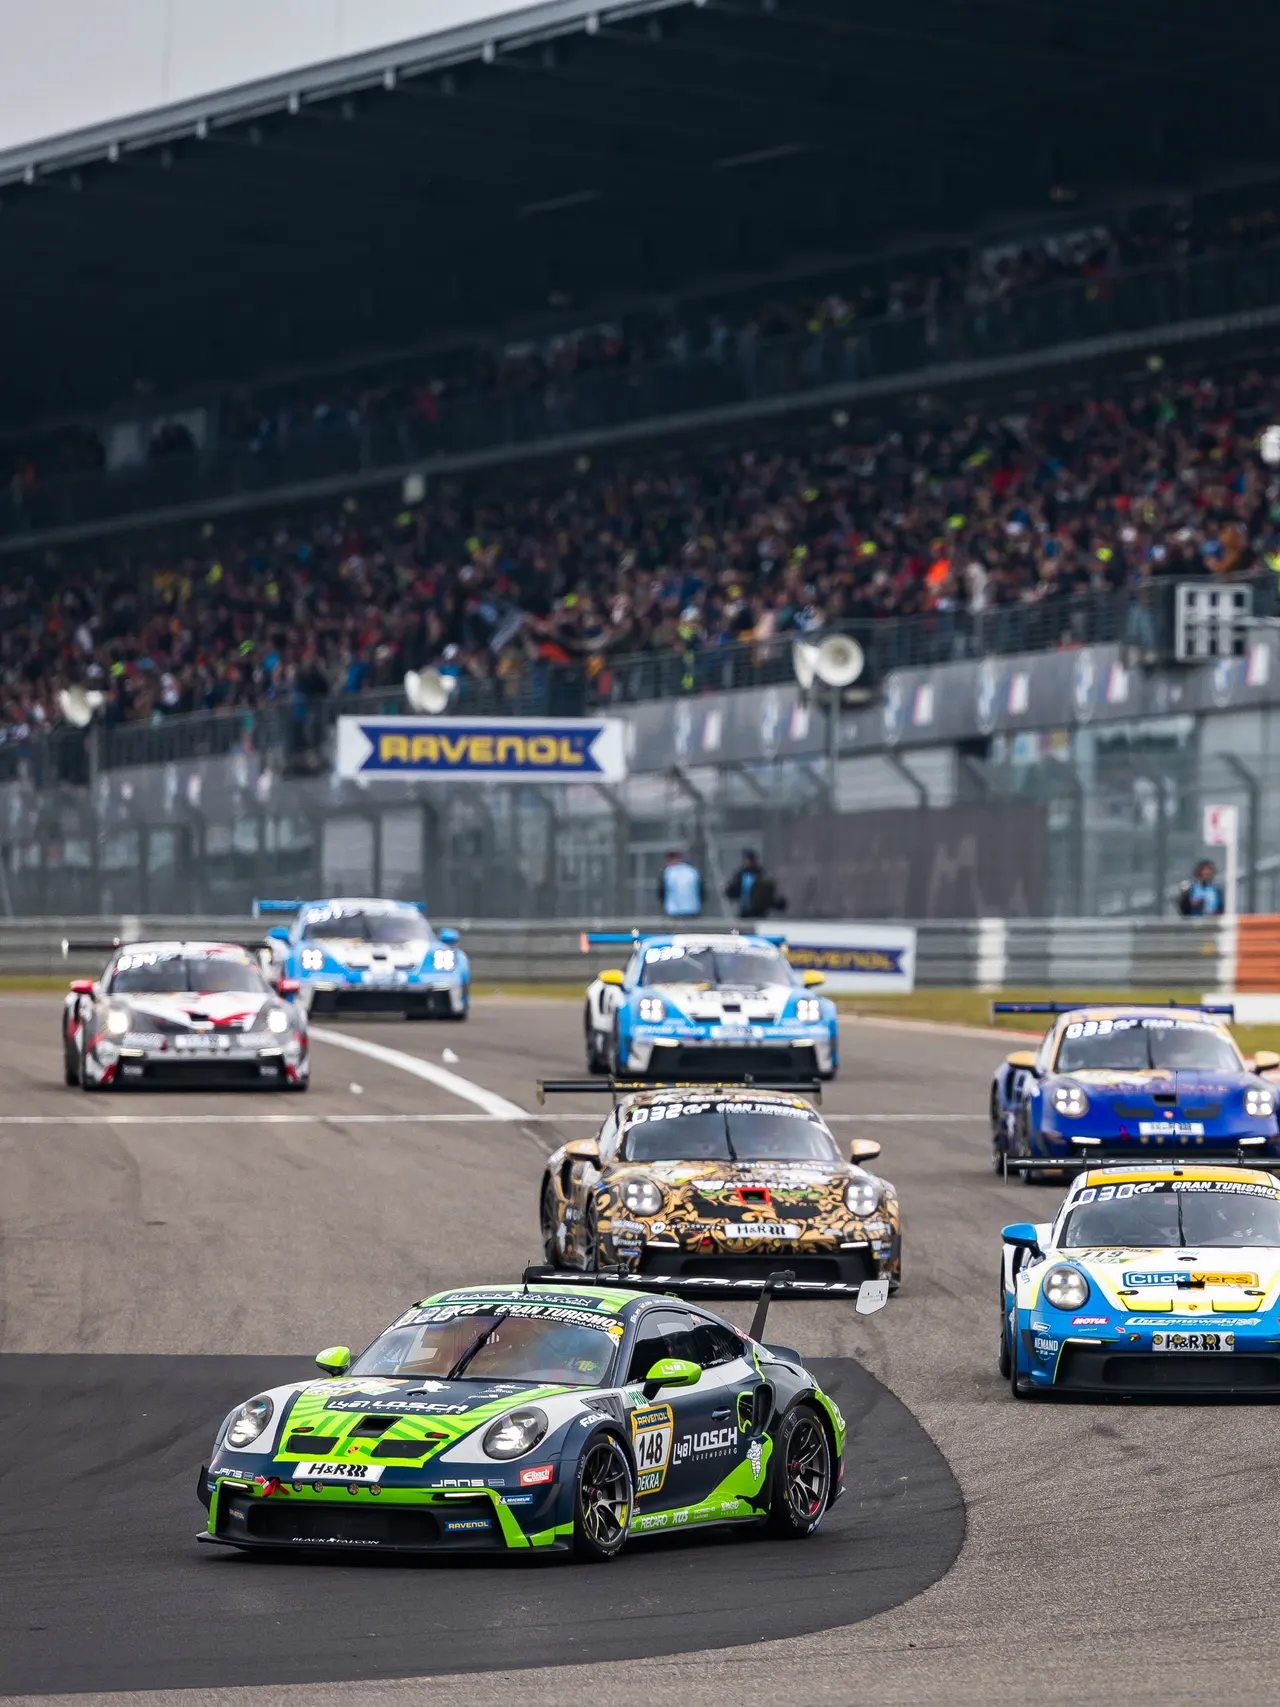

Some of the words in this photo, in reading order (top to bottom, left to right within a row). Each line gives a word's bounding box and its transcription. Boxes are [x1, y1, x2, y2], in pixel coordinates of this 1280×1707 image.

[380, 735, 583, 766] RAVENOL
[632, 1104, 683, 1124] 032
[1078, 1183, 1135, 1204] 030
[1172, 1181, 1218, 1191] GRAN
[1219, 1182, 1276, 1196] TURISMO
[737, 1225, 768, 1234] H&R
[526, 1293, 592, 1304] FALCON
[494, 1304, 541, 1316] GRAN
[543, 1307, 618, 1328] TURISMO
[530, 1314, 562, 1322] DRIVING
[563, 1318, 609, 1332] SIMULATOR
[1072, 1317, 1108, 1325] MOTUL
[1166, 1333, 1200, 1349] H&R
[372, 1400, 469, 1411] LOSCH
[637, 1412, 668, 1425] RAVENOL
[694, 1426, 738, 1451] LOSCH
[638, 1432, 664, 1467] 148
[691, 1449, 738, 1462] LUXEMBOURG
[215, 1467, 243, 1478] JANS
[308, 1462, 350, 1477] H&R
[432, 1479, 484, 1487] JANS
[637, 1474, 660, 1491] DEKRA
[448, 1520, 489, 1530] RAVENOL
[641, 1514, 668, 1530] RECARO
[335, 1538, 380, 1546] FALCON
